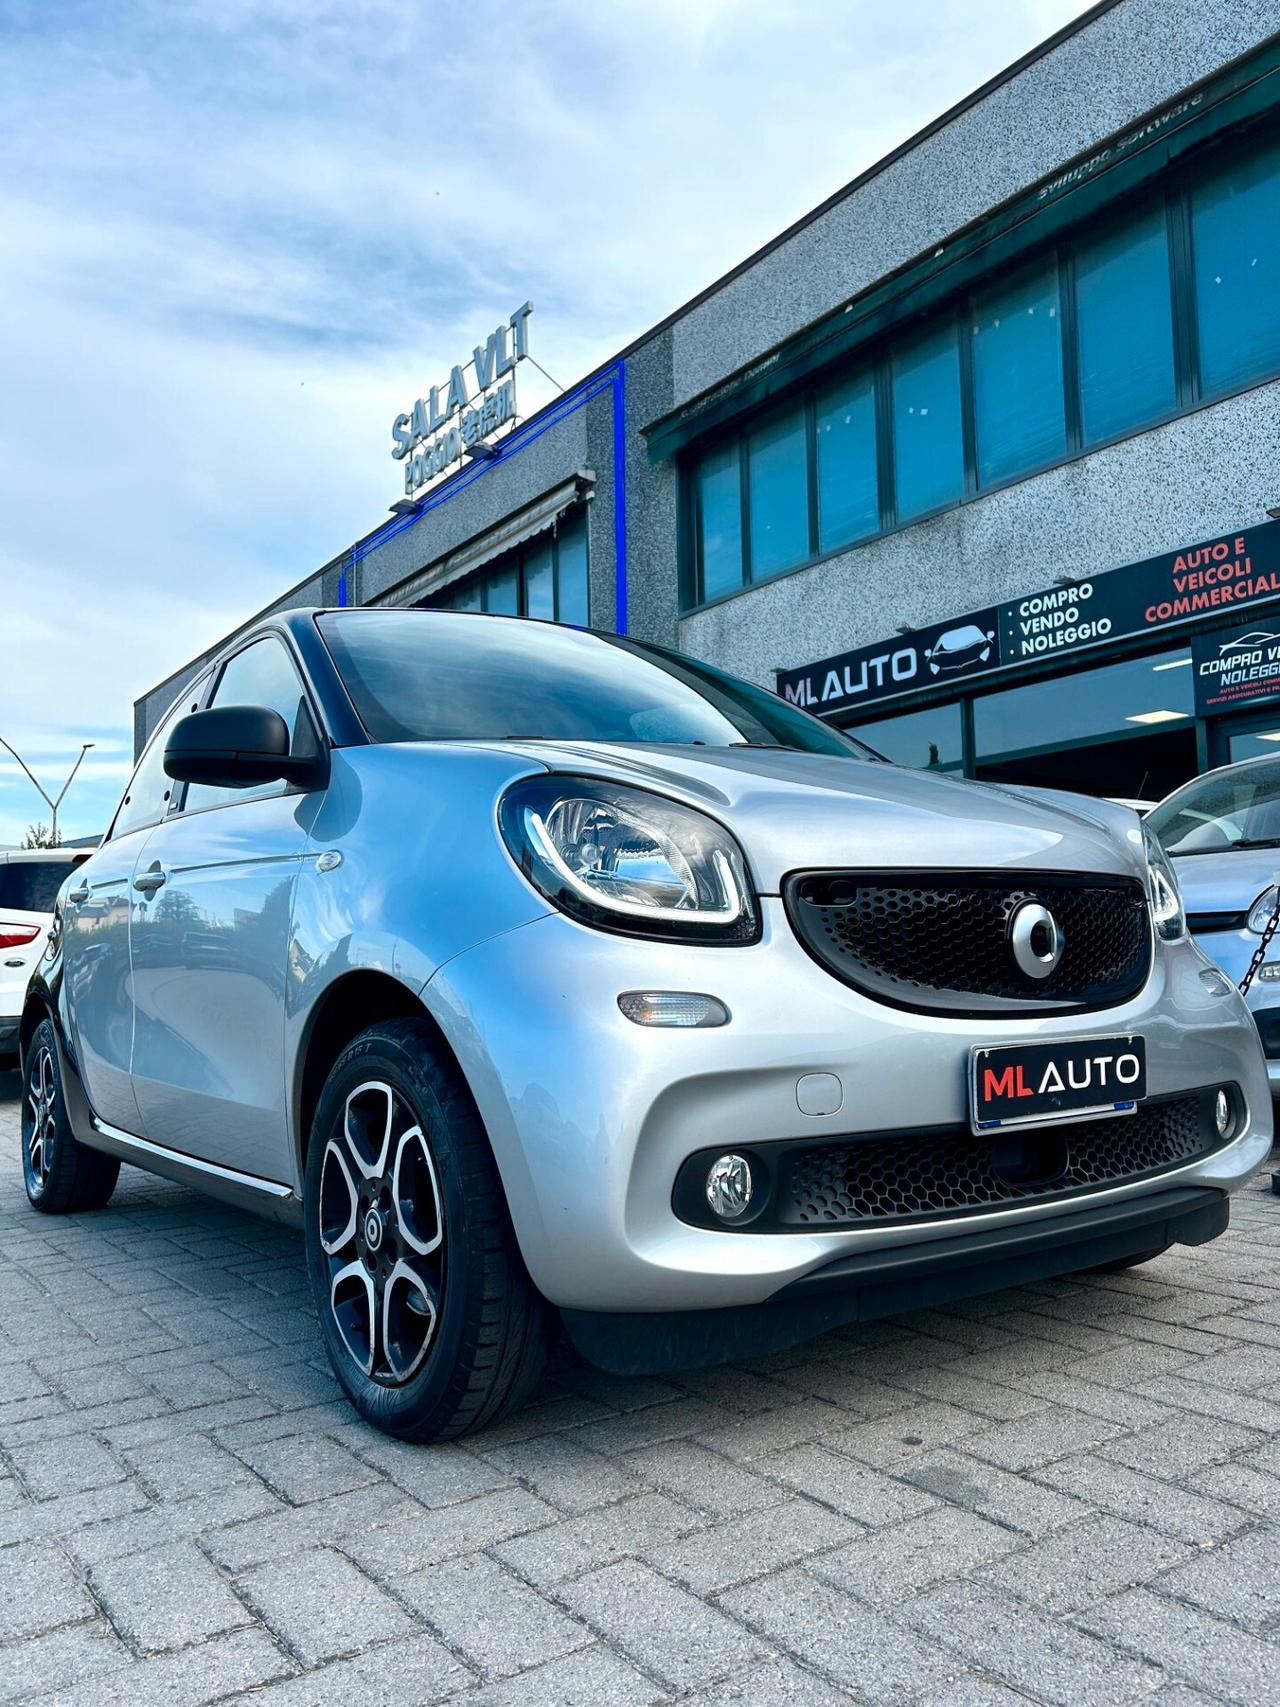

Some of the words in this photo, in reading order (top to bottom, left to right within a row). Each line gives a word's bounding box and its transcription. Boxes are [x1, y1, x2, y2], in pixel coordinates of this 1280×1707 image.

[392, 364, 468, 460] SALA
[473, 300, 534, 392] VLT
[405, 427, 462, 495] POGGIO
[1172, 542, 1229, 574] AUTO
[1234, 536, 1246, 555] E
[1172, 557, 1252, 593] VEICOLI
[1020, 583, 1093, 617] COMPRO
[1144, 572, 1280, 622] COMMERCIAL
[1020, 607, 1079, 636] VENDO
[1021, 618, 1112, 655] NOLEGGIO
[821, 647, 917, 701] AUTO
[1200, 650, 1263, 676] COMPRO
[984, 1065, 1034, 1102] ML
[1037, 1054, 1140, 1094] AUTO
